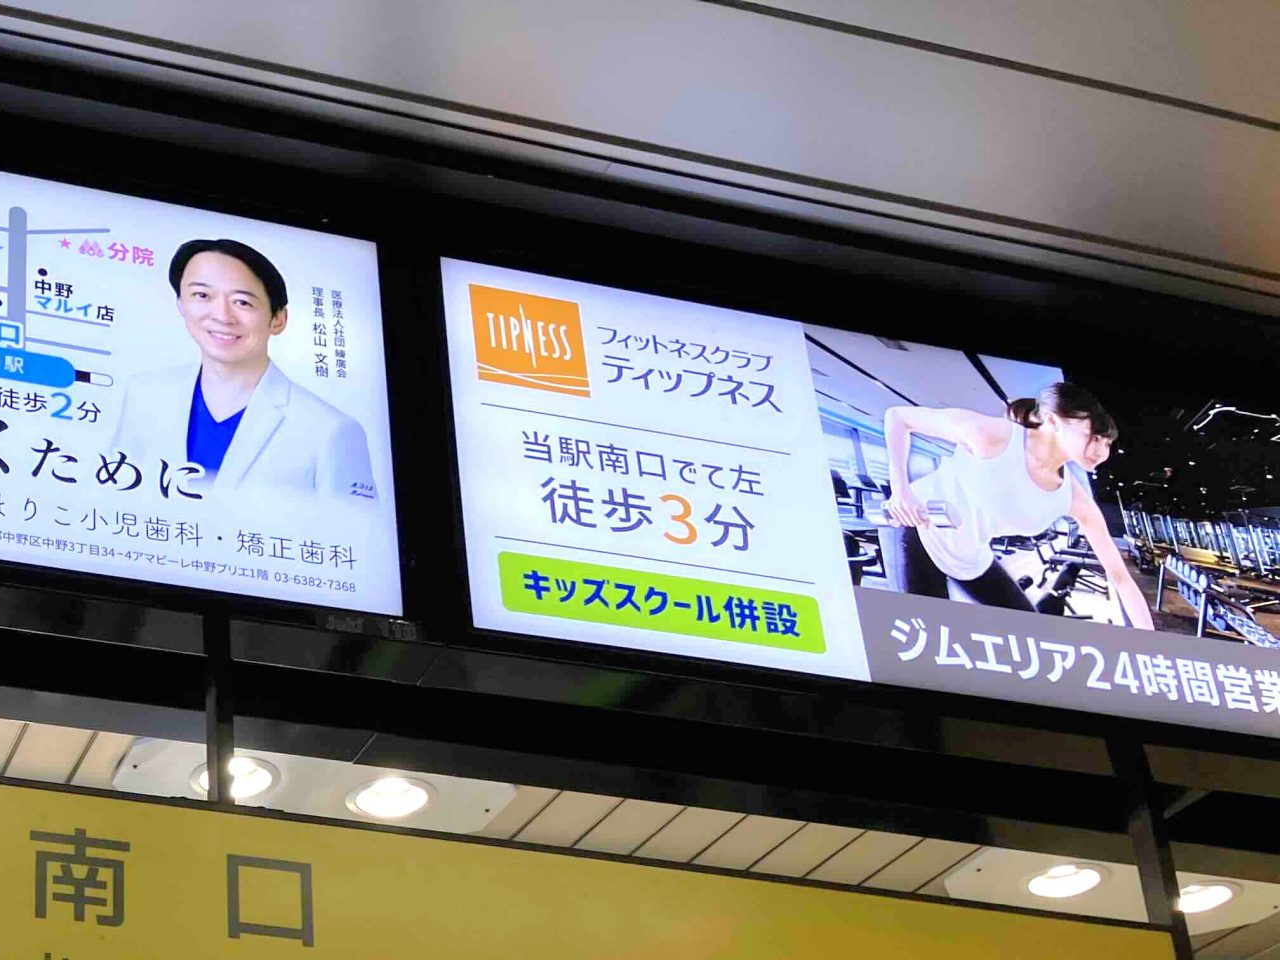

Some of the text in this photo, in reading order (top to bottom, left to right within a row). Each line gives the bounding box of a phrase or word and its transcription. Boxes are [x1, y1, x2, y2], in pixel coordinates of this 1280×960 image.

[108, 241, 156, 267] 分院
[35, 278, 74, 299] 中野
[36, 296, 116, 323] マルイ店
[313, 322, 327, 347] 松山
[486, 303, 572, 369] TIPNESS
[597, 325, 773, 372] フィットネスクラブ
[602, 357, 783, 414] ティップネス
[521, 429, 766, 498] 当駅南口でて左
[542, 478, 755, 552] 徒歩3分
[273, 570, 357, 593] 03-6382-7368
[523, 569, 802, 638] キッズスクール併設
